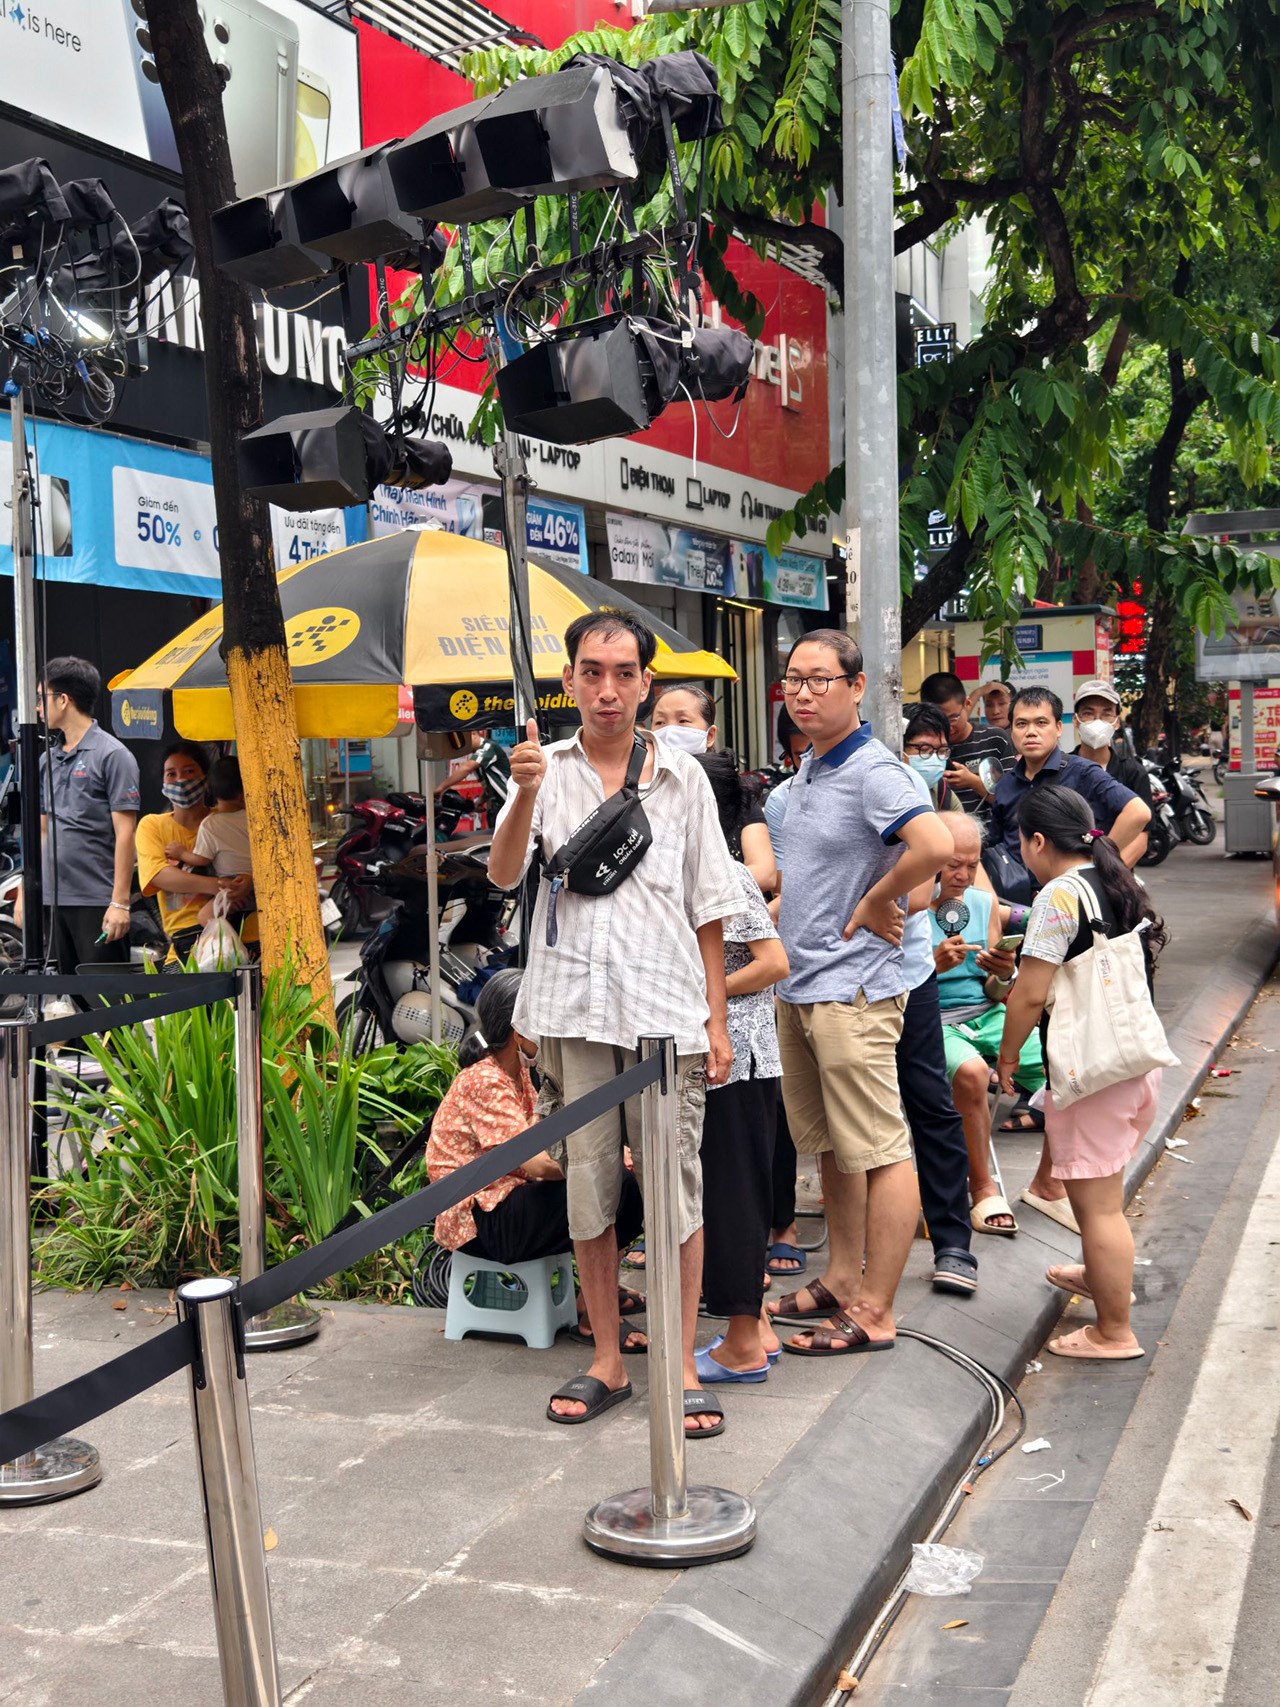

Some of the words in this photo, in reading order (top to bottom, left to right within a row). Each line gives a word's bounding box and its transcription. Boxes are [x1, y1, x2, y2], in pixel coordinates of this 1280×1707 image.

[28, 8, 40, 33] is
[45, 17, 82, 52] here
[917, 328, 951, 342] ELLY
[431, 412, 466, 442] CHỮA
[540, 443, 581, 470] LAPTOP
[138, 496, 161, 511] Giảm
[162, 499, 179, 513] đến
[703, 487, 731, 508] LAPTOP
[371, 503, 400, 524] Chính
[137, 511, 182, 547] 50%
[543, 513, 578, 548] 46%
[611, 547, 639, 571] Galaxy
[438, 634, 506, 660] ĐIỆN
